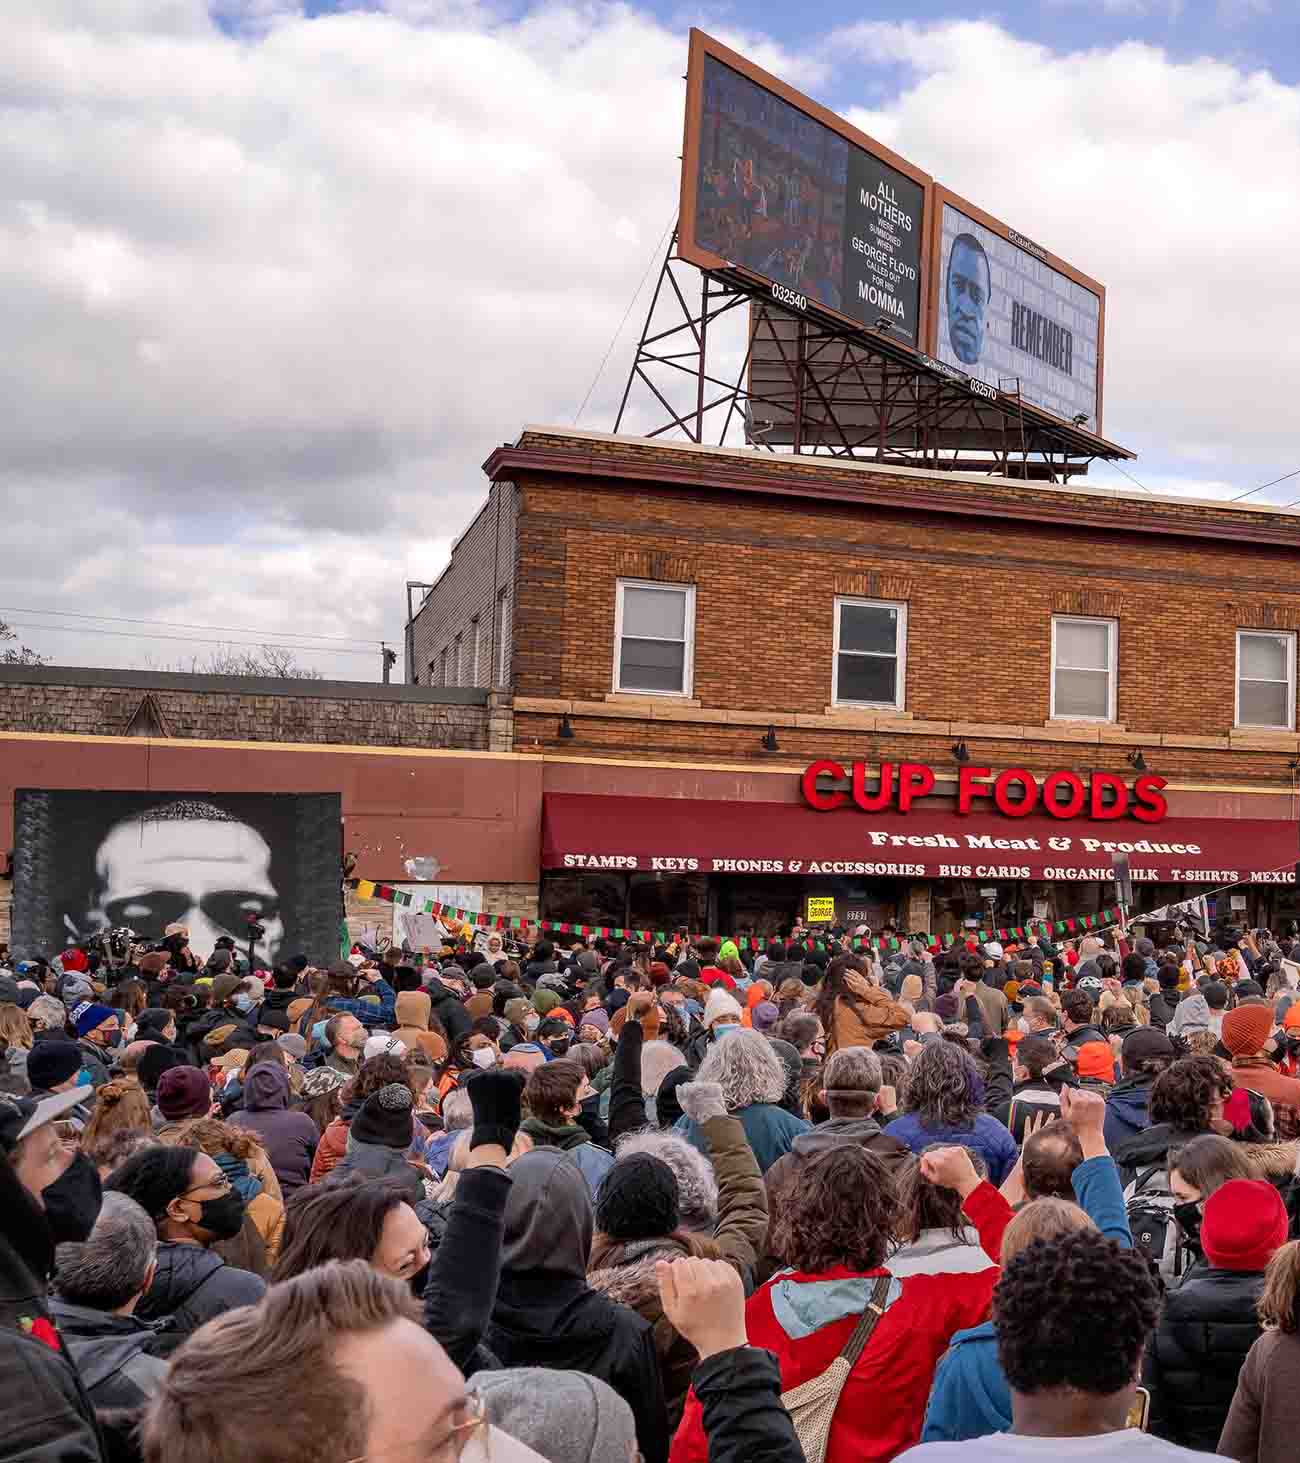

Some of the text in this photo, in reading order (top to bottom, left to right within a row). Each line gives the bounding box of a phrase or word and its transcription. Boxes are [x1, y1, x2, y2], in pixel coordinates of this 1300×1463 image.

[877, 181, 898, 205] ALL
[860, 188, 912, 232] MOTHERS
[869, 223, 901, 247] SUMMONED
[878, 217, 895, 233] WERE
[876, 239, 894, 253] WHEN
[852, 237, 916, 281] GEORGE FLOYD
[866, 260, 901, 283] CALLED OUT
[872, 274, 895, 293] FOR HIS
[772, 283, 807, 310] 032540
[858, 280, 905, 319] MOMMA
[1011, 301, 1073, 376] REMEMBER
[970, 379, 997, 400] 032570
[802, 759, 1169, 823] CUP FOODS
[868, 831, 1201, 854] Fresh Meat & Produce
[564, 854, 638, 868] STAMPS
[651, 857, 699, 870] KEYS
[712, 859, 784, 872] PHONES
[788, 860, 802, 872] &
[808, 861, 925, 876] ACCESSORIES
[938, 864, 972, 877] BUS
[975, 866, 1030, 878] CARDS
[1043, 868, 1115, 881] ORGANIC
[1171, 869, 1239, 881] T-SHIRTS
[1250, 870, 1296, 882] MEXIC
